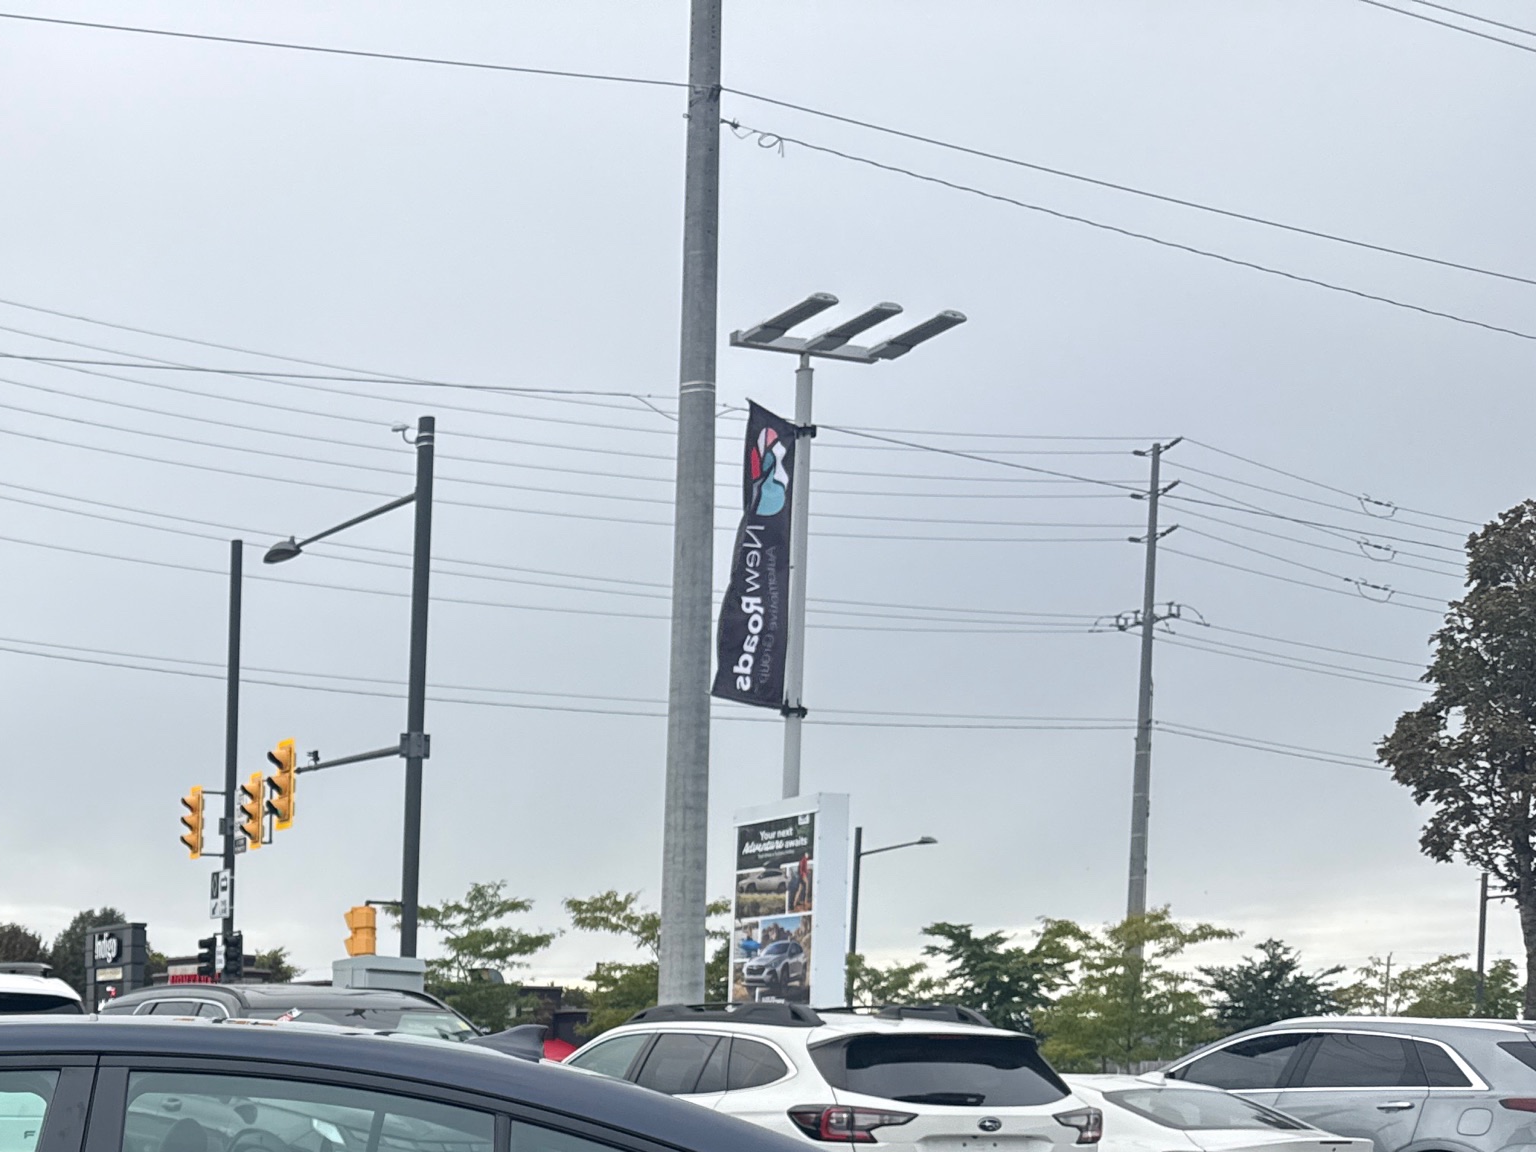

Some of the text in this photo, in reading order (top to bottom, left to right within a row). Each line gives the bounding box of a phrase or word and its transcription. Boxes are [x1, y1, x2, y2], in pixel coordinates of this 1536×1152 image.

[759, 827, 794, 841] Your next
[785, 836, 808, 848] awaits
